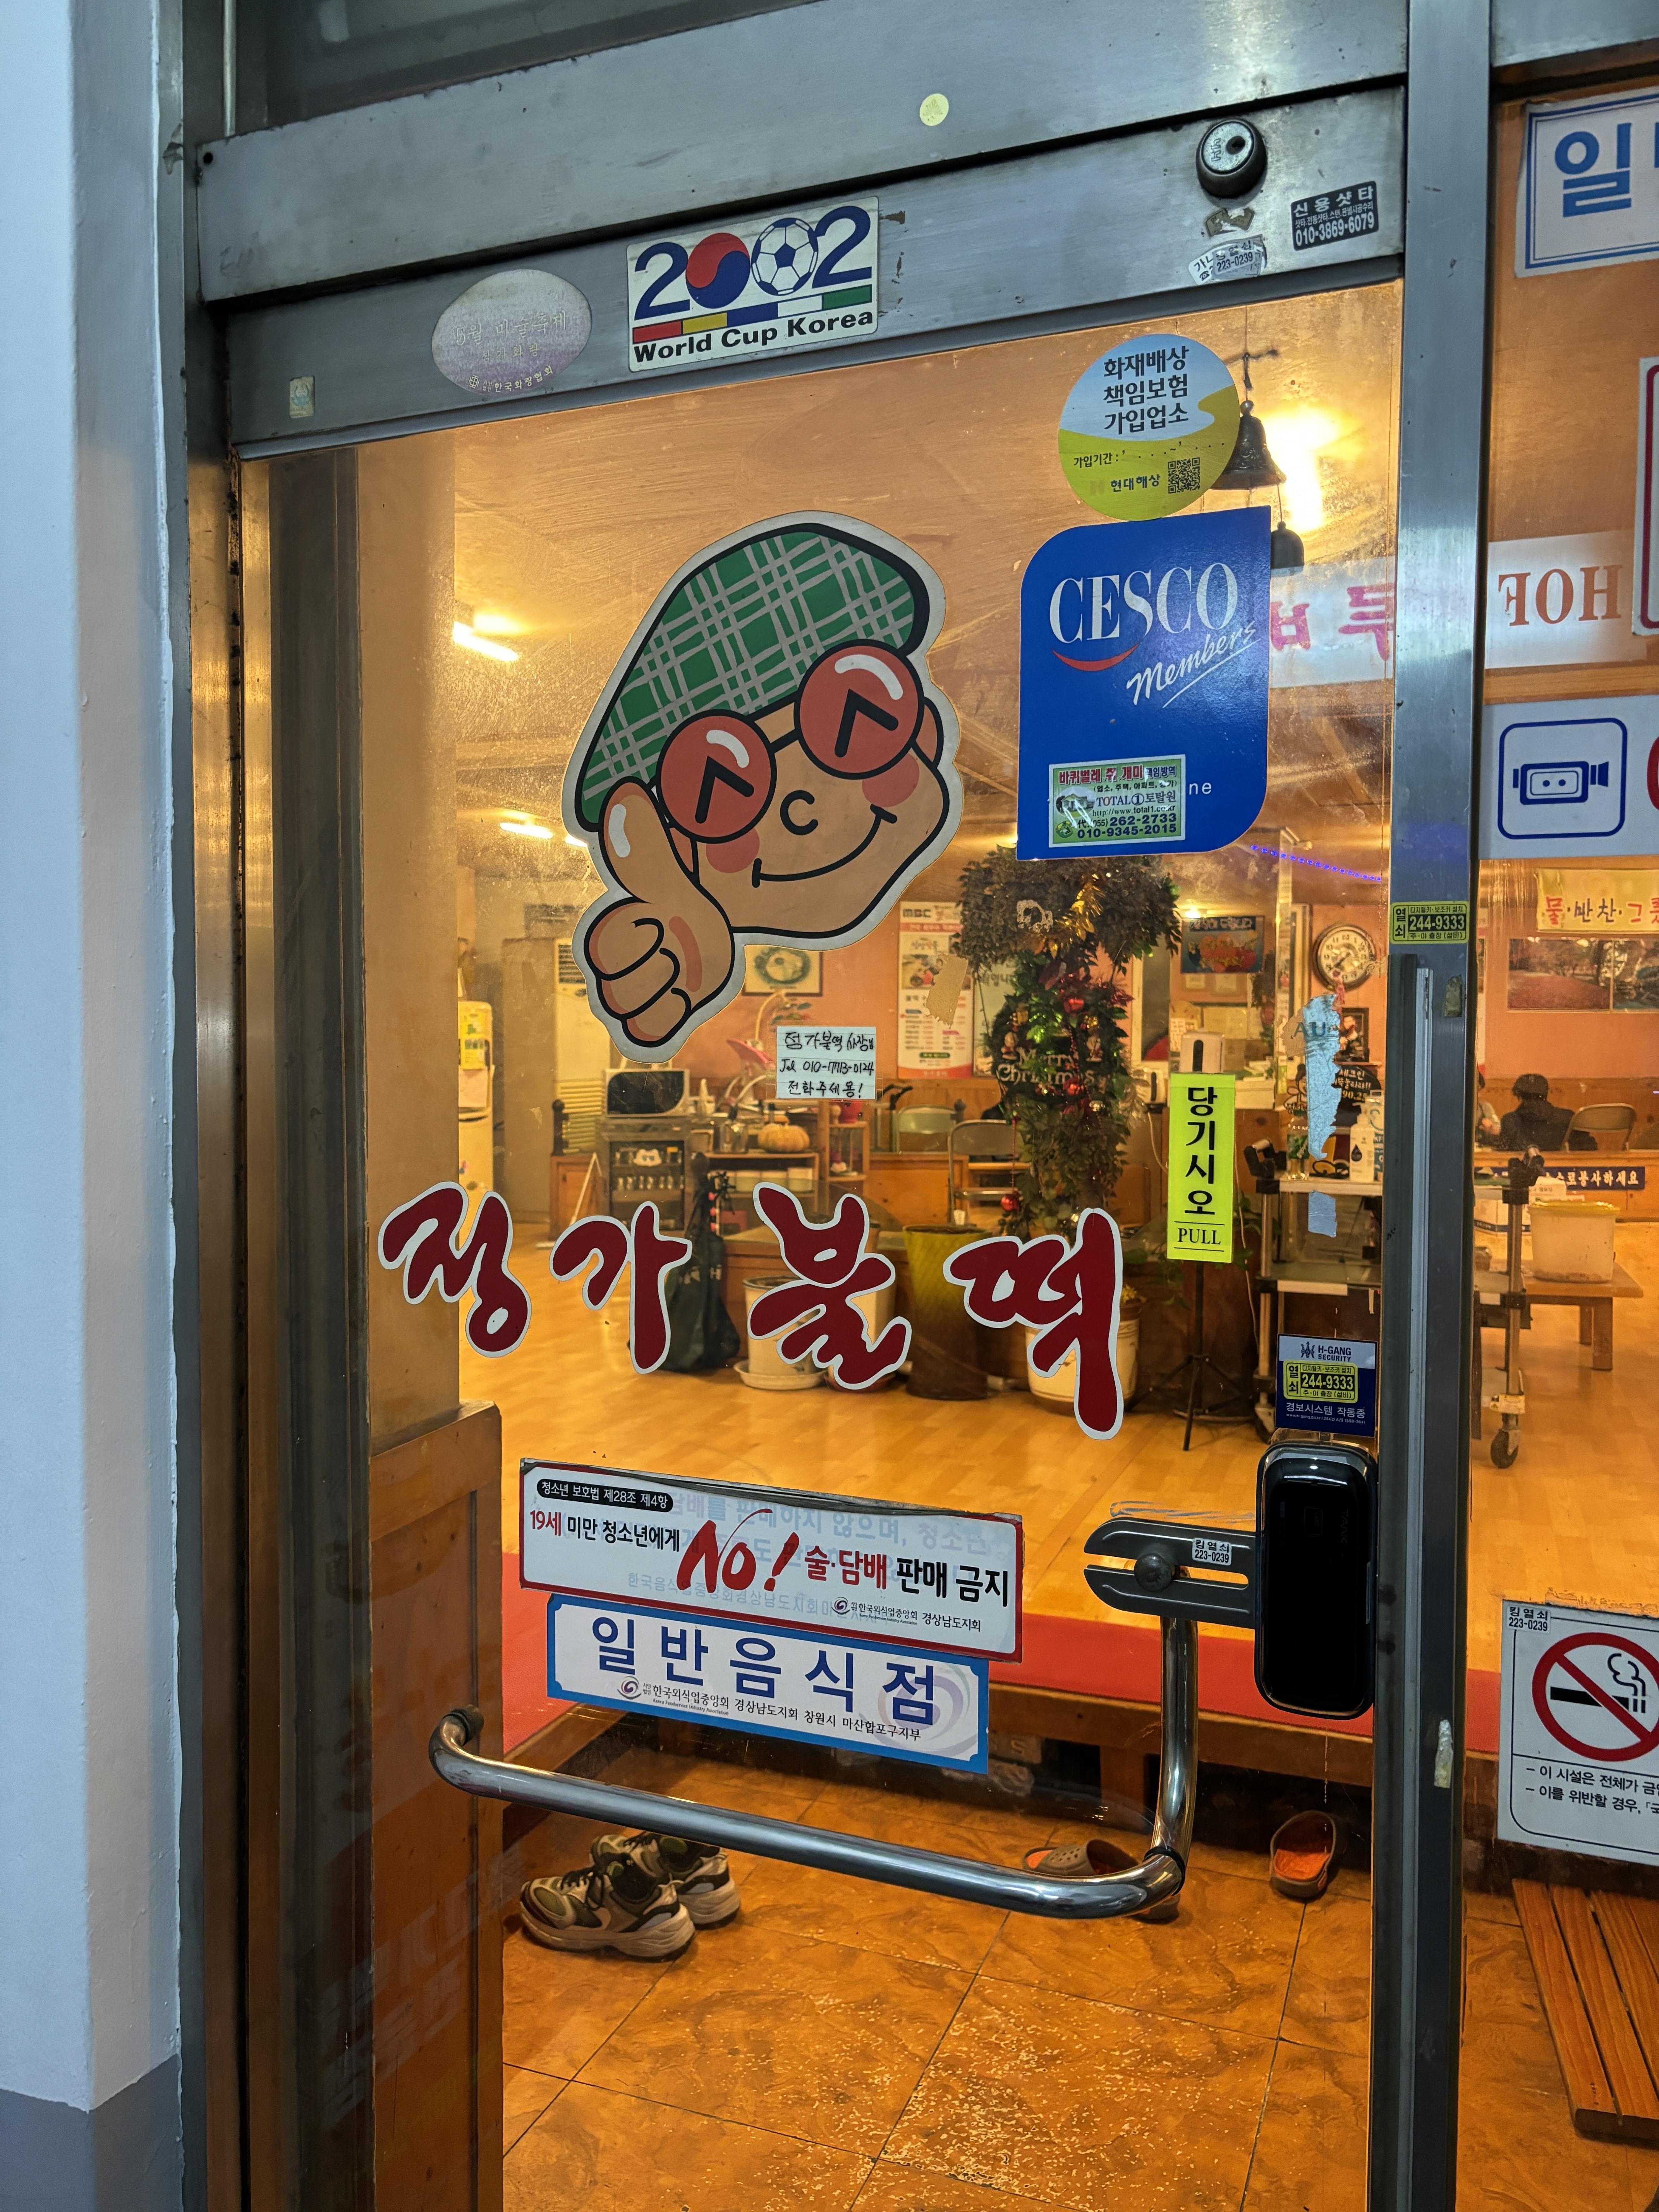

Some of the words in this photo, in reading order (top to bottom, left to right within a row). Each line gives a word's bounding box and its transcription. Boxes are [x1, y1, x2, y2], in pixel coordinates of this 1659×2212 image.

[1296, 211, 1374, 246] 010-3869-6079
[1217, 252, 1253, 272] 223-0239
[634, 333, 711, 362] World
[721, 325, 778, 347] Cup
[788, 311, 873, 338] Korea
[1104, 346, 1189, 379] 화재배상
[495, 365, 553, 393] 한국화랑협회
[1104, 374, 1188, 407] 책임보험
[1104, 403, 1188, 434] 가입업소
[1110, 474, 1161, 493] 현대해상
[1049, 563, 1238, 644] CESCO
[1126, 621, 1259, 706] Members
[1077, 823, 1176, 839] 010-9345-2015
[1110, 813, 1177, 826] 262-2733
[1395, 907, 1406, 939] 열쇠
[1409, 915, 1465, 930] 244-9333
[1185, 1086, 1218, 1215] 당기시오
[1178, 1228, 1221, 1245] PULL
[1318, 1345, 1352, 1356] H-GANG
[1318, 1354, 1351, 1362] SECURITY
[1288, 1365, 1298, 1394] 열쇠
[1302, 1374, 1353, 1390] 244-9333
[1286, 1402, 1333, 1416] 경보시스템
[1337, 1407, 1365, 1419] 작동중
[542, 1482, 568, 1497] 청소년
[573, 1485, 599, 1501] 보호법
[604, 1489, 636, 1504] 제28조
[640, 1493, 668, 1509] 제4항
[530, 1510, 561, 1537] 19세
[568, 1516, 598, 1541] 미만
[603, 1520, 680, 1552] 청소년에게
[896, 1558, 947, 1599] 판매
[955, 1565, 1008, 1607] 금지
[1194, 1549, 1230, 1563] 223-0239
[859, 1602, 917, 1621] 한국외식업중앙회
[922, 1612, 981, 1632] 경상남도지회
[1509, 1617, 1548, 1632] 223-0239
[1510, 1606, 1548, 1621] 킹열쇠
[592, 1616, 934, 1726] 일반음식점
[653, 1684, 729, 1709] 한국외식업중앙회
[735, 1698, 798, 1721] 경상남도지회
[804, 1709, 836, 1728] 창원시
[842, 1718, 921, 1742] 마산합포구지부
[1540, 1766, 1551, 1779] 이
[1556, 1768, 1595, 1786] 시설은
[1599, 1775, 1639, 1793] 전체가
[1539, 1786, 1565, 1801] 이를
[1568, 1790, 1607, 1808] 위반할
[1612, 1797, 1641, 1814] 경우,
